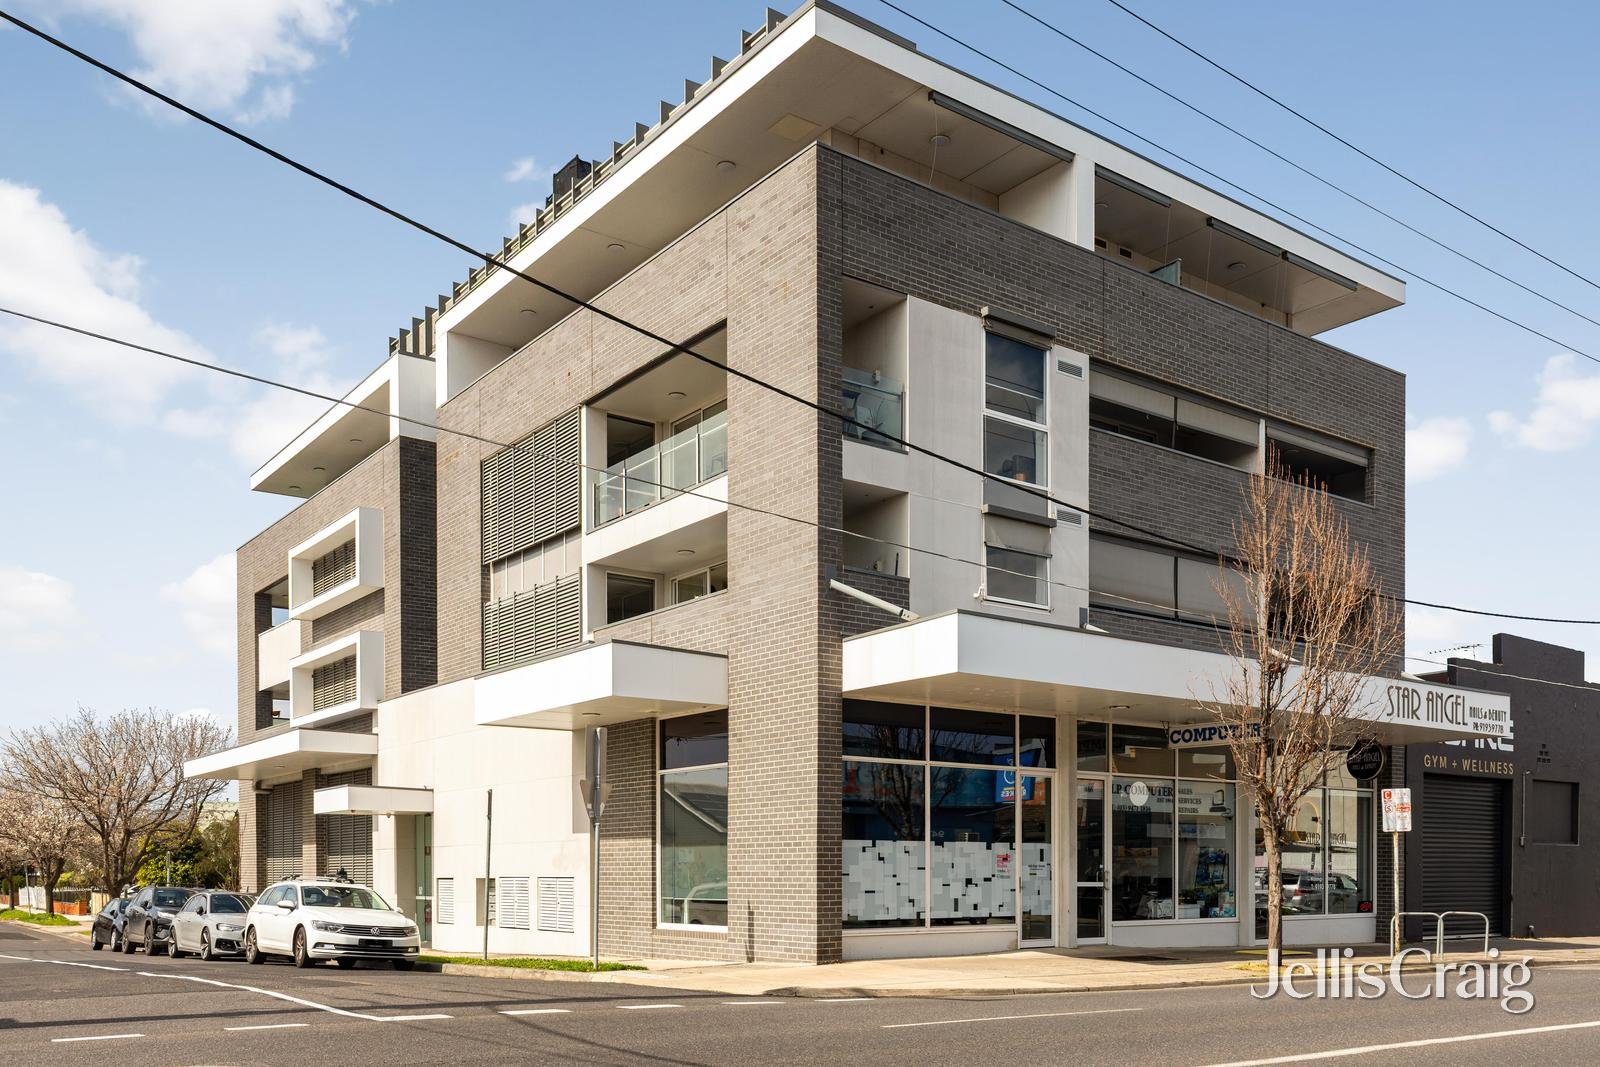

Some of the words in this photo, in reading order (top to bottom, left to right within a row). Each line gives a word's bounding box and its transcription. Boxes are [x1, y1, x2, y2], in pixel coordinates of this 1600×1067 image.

[1386, 685, 1421, 721] STAR
[1426, 691, 1468, 726] ANGEL
[1469, 706, 1483, 720] NAILS
[1488, 708, 1507, 723] BEAUTY
[1423, 754, 1447, 769] GYM
[1451, 760, 1457, 769] +
[1461, 758, 1514, 775] WELLNESS
